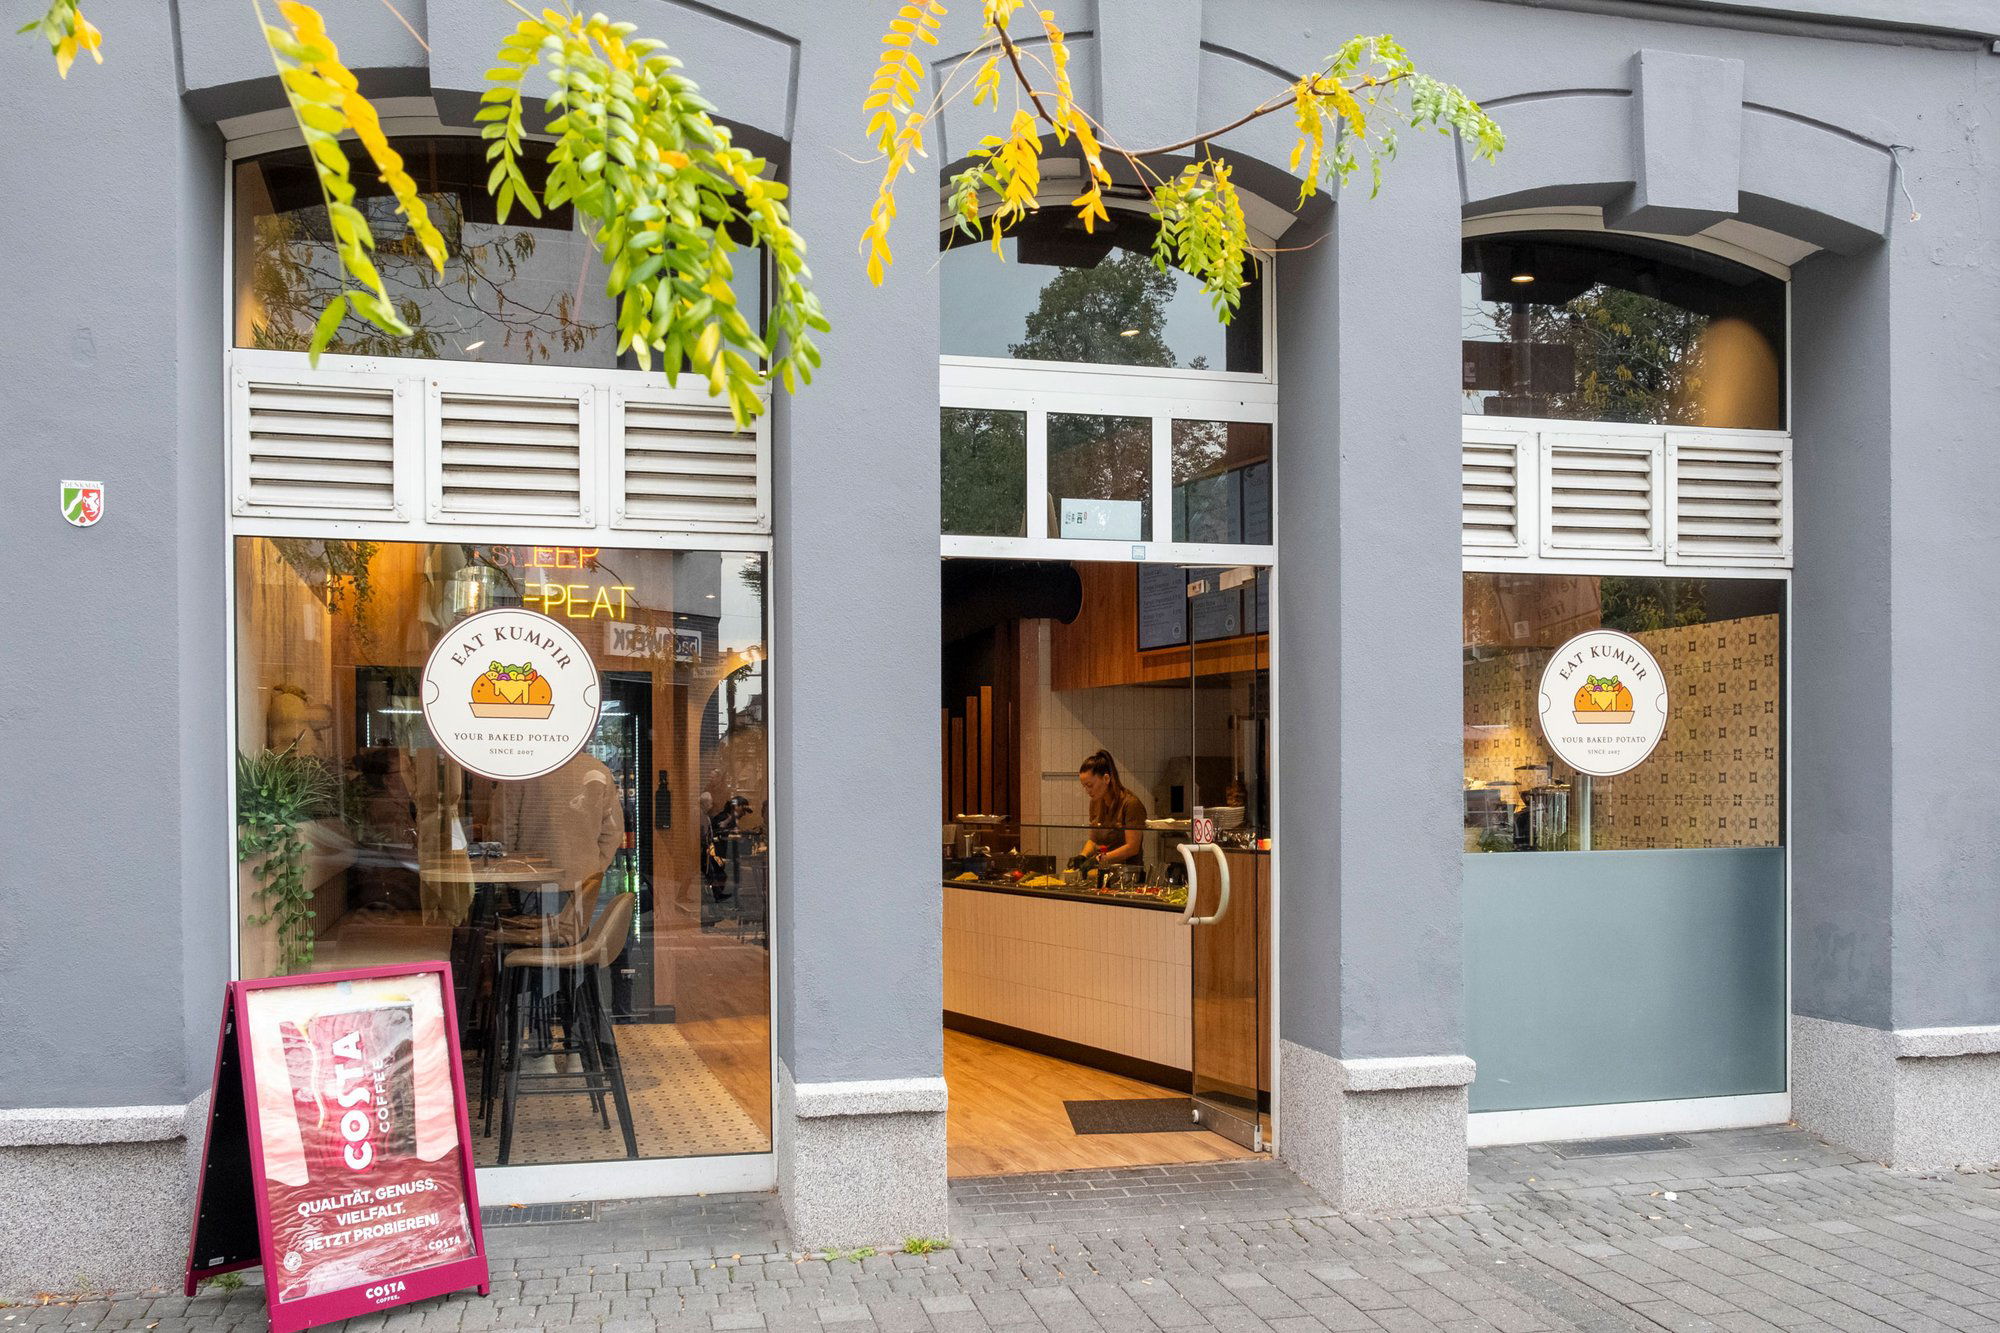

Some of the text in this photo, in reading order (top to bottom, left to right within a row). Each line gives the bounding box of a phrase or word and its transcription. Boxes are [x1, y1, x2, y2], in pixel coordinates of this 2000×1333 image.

[451, 626, 571, 670] EAT KUMPIR
[1559, 645, 1647, 680] EAT KUMPIR
[454, 732, 570, 742] YOUR BAKED POTATO
[1562, 736, 1647, 744] YOUR BAKED POTATO
[332, 1030, 373, 1170] COSTA
[372, 1059, 391, 1134] COFFEE
[297, 1177, 438, 1217] QUALITÄT, GENUSS,
[336, 1201, 407, 1227] VIELFALT.
[303, 1212, 440, 1253] JETZT PROBIEREN!
[428, 1235, 461, 1251] COSTA
[365, 1281, 406, 1299] COSTA
